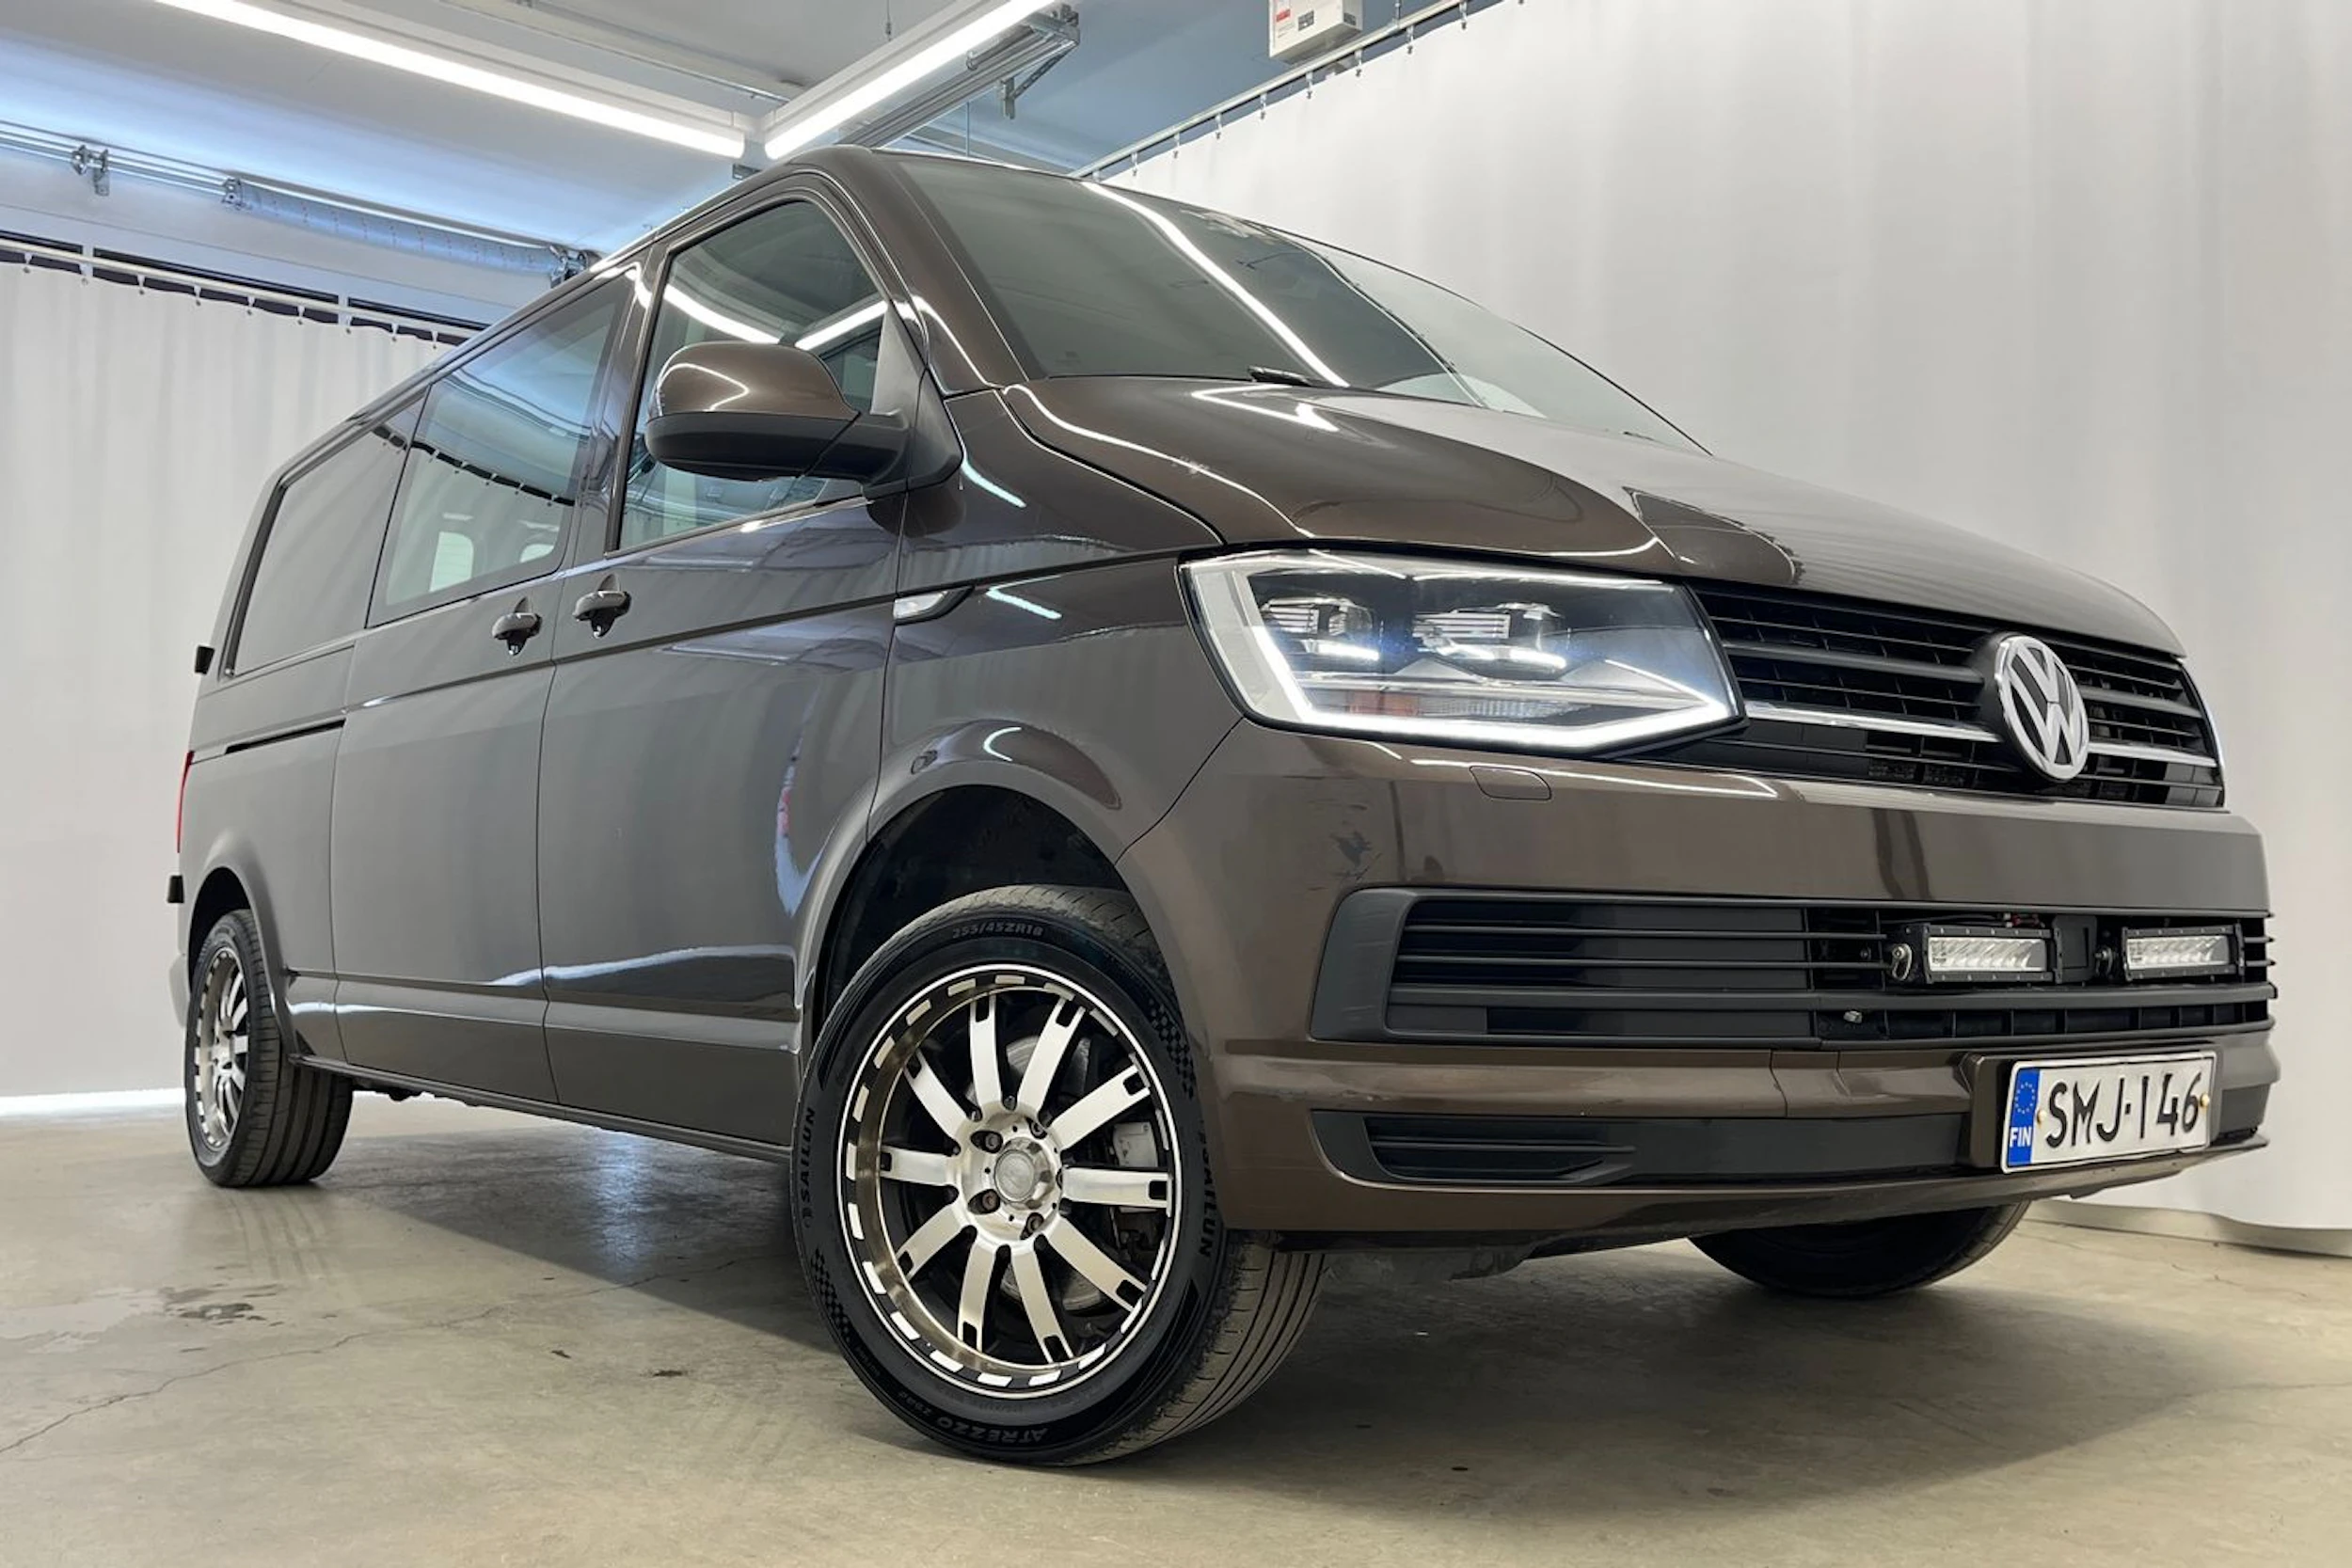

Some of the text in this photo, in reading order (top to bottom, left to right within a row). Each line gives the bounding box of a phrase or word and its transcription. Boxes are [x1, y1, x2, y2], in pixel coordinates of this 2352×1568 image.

[2045, 1071, 2202, 1148] SMJ-146
[801, 1107, 816, 1203] SAILUN
[2009, 1126, 2032, 1148] FIN
[935, 1417, 1052, 1445] ATREZZO
